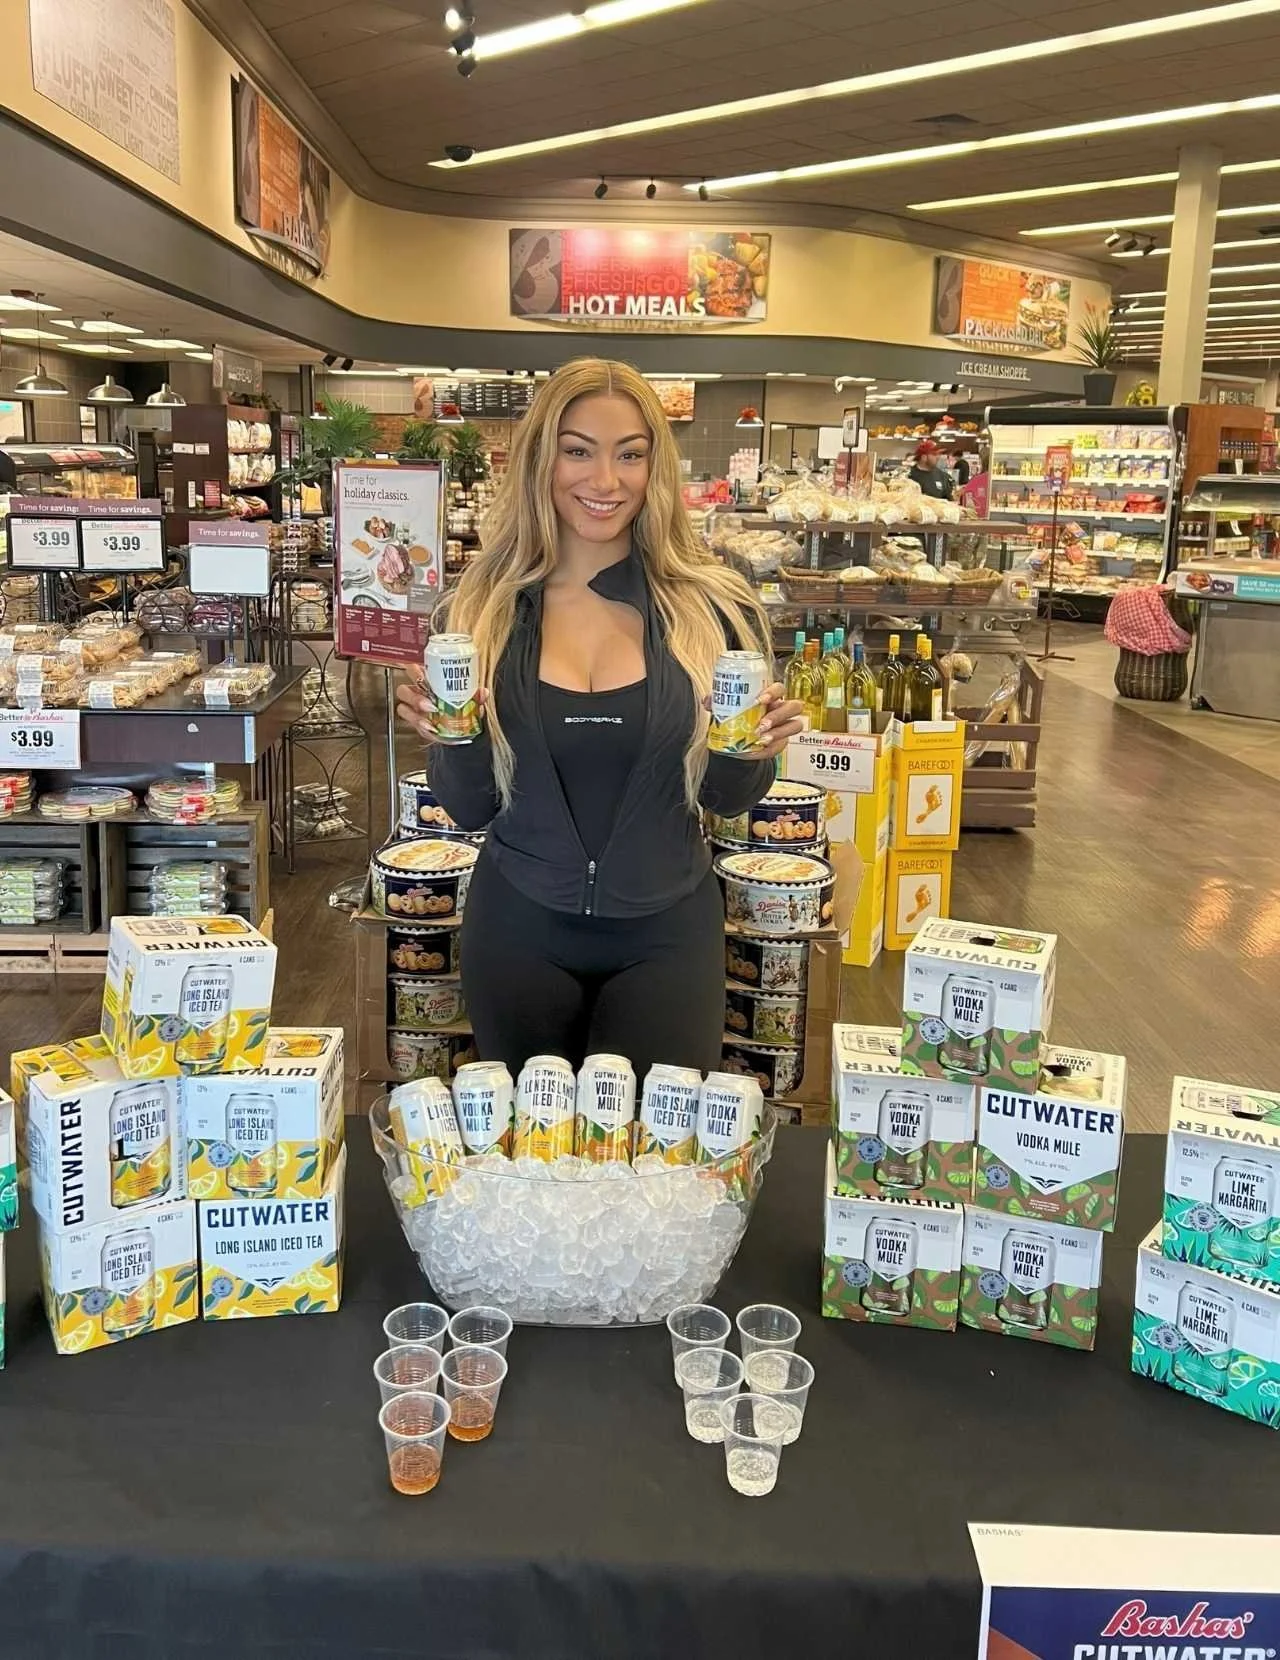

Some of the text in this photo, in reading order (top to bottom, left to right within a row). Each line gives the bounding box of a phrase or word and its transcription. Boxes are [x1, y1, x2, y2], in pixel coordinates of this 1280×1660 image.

[574, 272, 680, 294] FRESH GO
[569, 295, 706, 317] HOT MEALS
[961, 361, 1028, 379] ICE CREAM SHOPPE
[344, 474, 378, 486] Time for
[344, 487, 411, 501] holiday classics.
[19, 503, 38, 512] Time
[38, 503, 50, 512] for
[88, 505, 107, 513] Time
[107, 505, 119, 513] for
[33, 531, 70, 546] $3.99
[198, 528, 218, 537] Time
[218, 529, 229, 538] for
[103, 536, 141, 551] $3.99
[440, 657, 472, 665] CUTWATER
[442, 666, 471, 679] VODKA
[446, 679, 469, 691] MULE
[721, 681, 750, 695] ISLAND
[726, 694, 742, 707] TEA
[11, 730, 54, 747] $3.99
[799, 736, 823, 744] Better
[809, 753, 851, 772] $9.99
[908, 760, 955, 771] BAREFOOT
[898, 859, 944, 871] BAREFOOT
[145, 940, 268, 951] CUTWATER
[913, 945, 1037, 971] CUTWATER
[190, 979, 226, 987] CUTWATER
[183, 989, 230, 1002] LONG ISLAND
[951, 986, 988, 998] CUTWATER
[188, 1001, 223, 1013] ICED TEA
[952, 994, 985, 1012] VODKA
[954, 1007, 981, 1024] MULE
[1055, 1056, 1093, 1068] VODKA
[657, 1083, 695, 1095] CUTWATER
[597, 1097, 622, 1112] MULE
[647, 1093, 700, 1114] LONG ISLAND
[706, 1092, 743, 1104] CUTWATER
[119, 1099, 161, 1116] CUTWATER
[706, 1103, 737, 1122] VODKA
[888, 1102, 925, 1112] CUTWATER
[986, 1093, 1114, 1135] CUTWATER
[113, 1109, 166, 1135] LONG ISLAND
[228, 1118, 274, 1129] LONG ISLAND
[465, 1117, 492, 1132] MULE
[653, 1109, 692, 1129] ICED TEA
[890, 1111, 921, 1126] VODKA
[144, 1125, 161, 1140] TEA
[235, 1129, 268, 1141] ICED TEA
[707, 1120, 733, 1137] MULE
[890, 1123, 918, 1138] MULE
[1016, 1131, 1082, 1157] VODKA MULE
[60, 1098, 84, 1226] CUTWATER
[1224, 1169, 1266, 1184] CUTWATER
[1231, 1180, 1257, 1198] LIME
[1218, 1191, 1268, 1215] MARGARITA
[206, 1202, 330, 1228] CUTWATER
[875, 1228, 911, 1239] CUTWATER
[110, 1243, 148, 1256] CUTWATER
[215, 1235, 323, 1254] LONG ISLAND ICED TEA
[876, 1237, 907, 1254] VODKA
[1011, 1240, 1048, 1254] CUTWATER
[104, 1251, 152, 1273] LONG ISLAND
[877, 1250, 904, 1266] MULE
[1012, 1249, 1044, 1267] VODKA
[111, 1264, 147, 1282] ICED TEA
[1013, 1262, 1041, 1280] MULE
[1188, 1294, 1228, 1314] CUTWATER
[1195, 1306, 1219, 1326] LIME
[1182, 1314, 1229, 1346] MARGARITA
[976, 1528, 1025, 1537] BASHAS'
[1101, 1599, 1255, 1639] Bashas'
